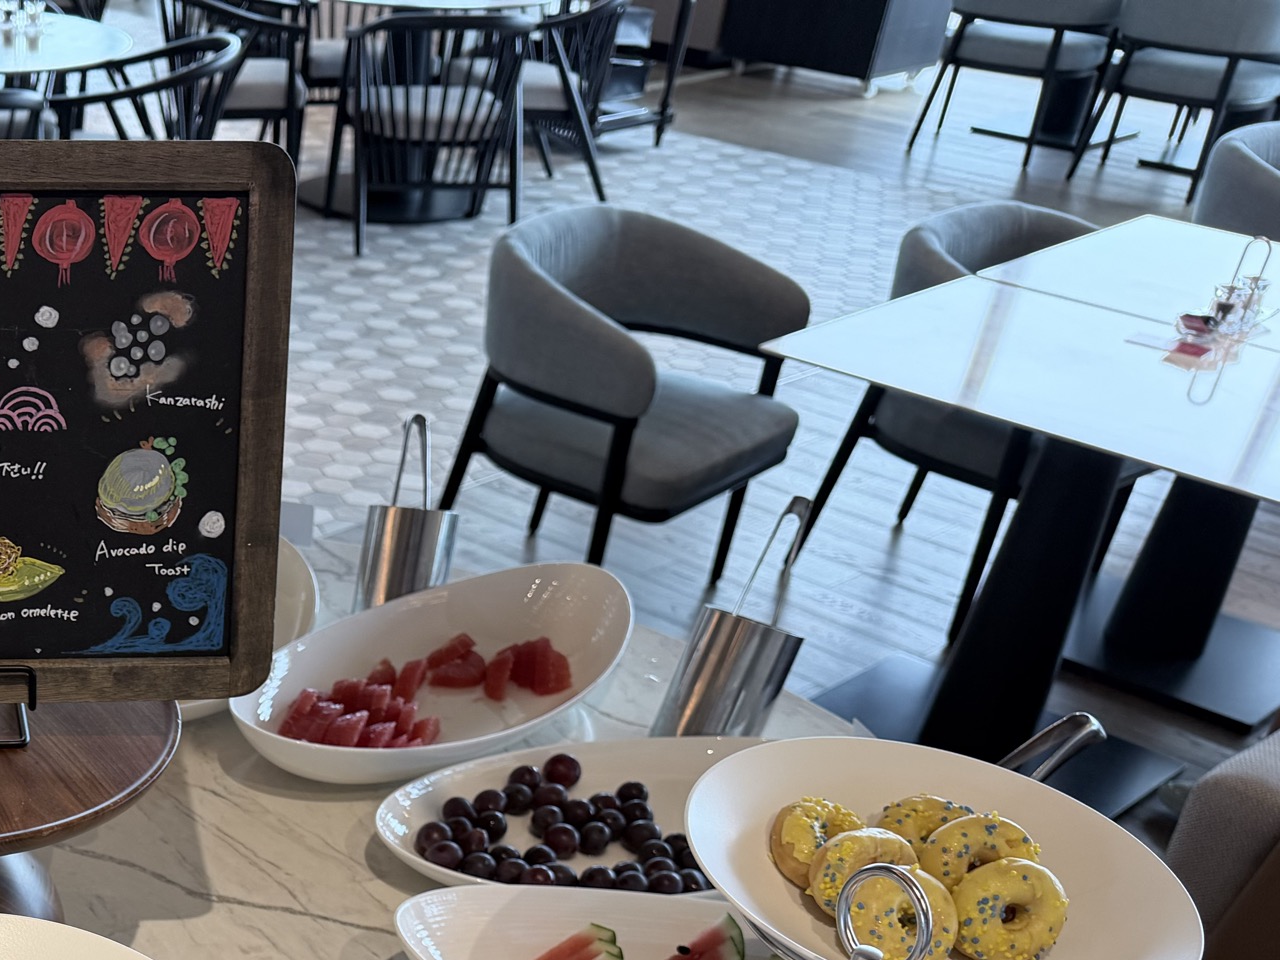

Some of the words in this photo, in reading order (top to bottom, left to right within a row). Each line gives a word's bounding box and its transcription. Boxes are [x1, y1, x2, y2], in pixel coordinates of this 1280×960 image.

[145, 384, 226, 410] Kanzarashi
[94, 540, 156, 562] Avocado
[162, 538, 187, 554] dip
[145, 563, 191, 576] Toast
[21, 604, 79, 622] omelette
